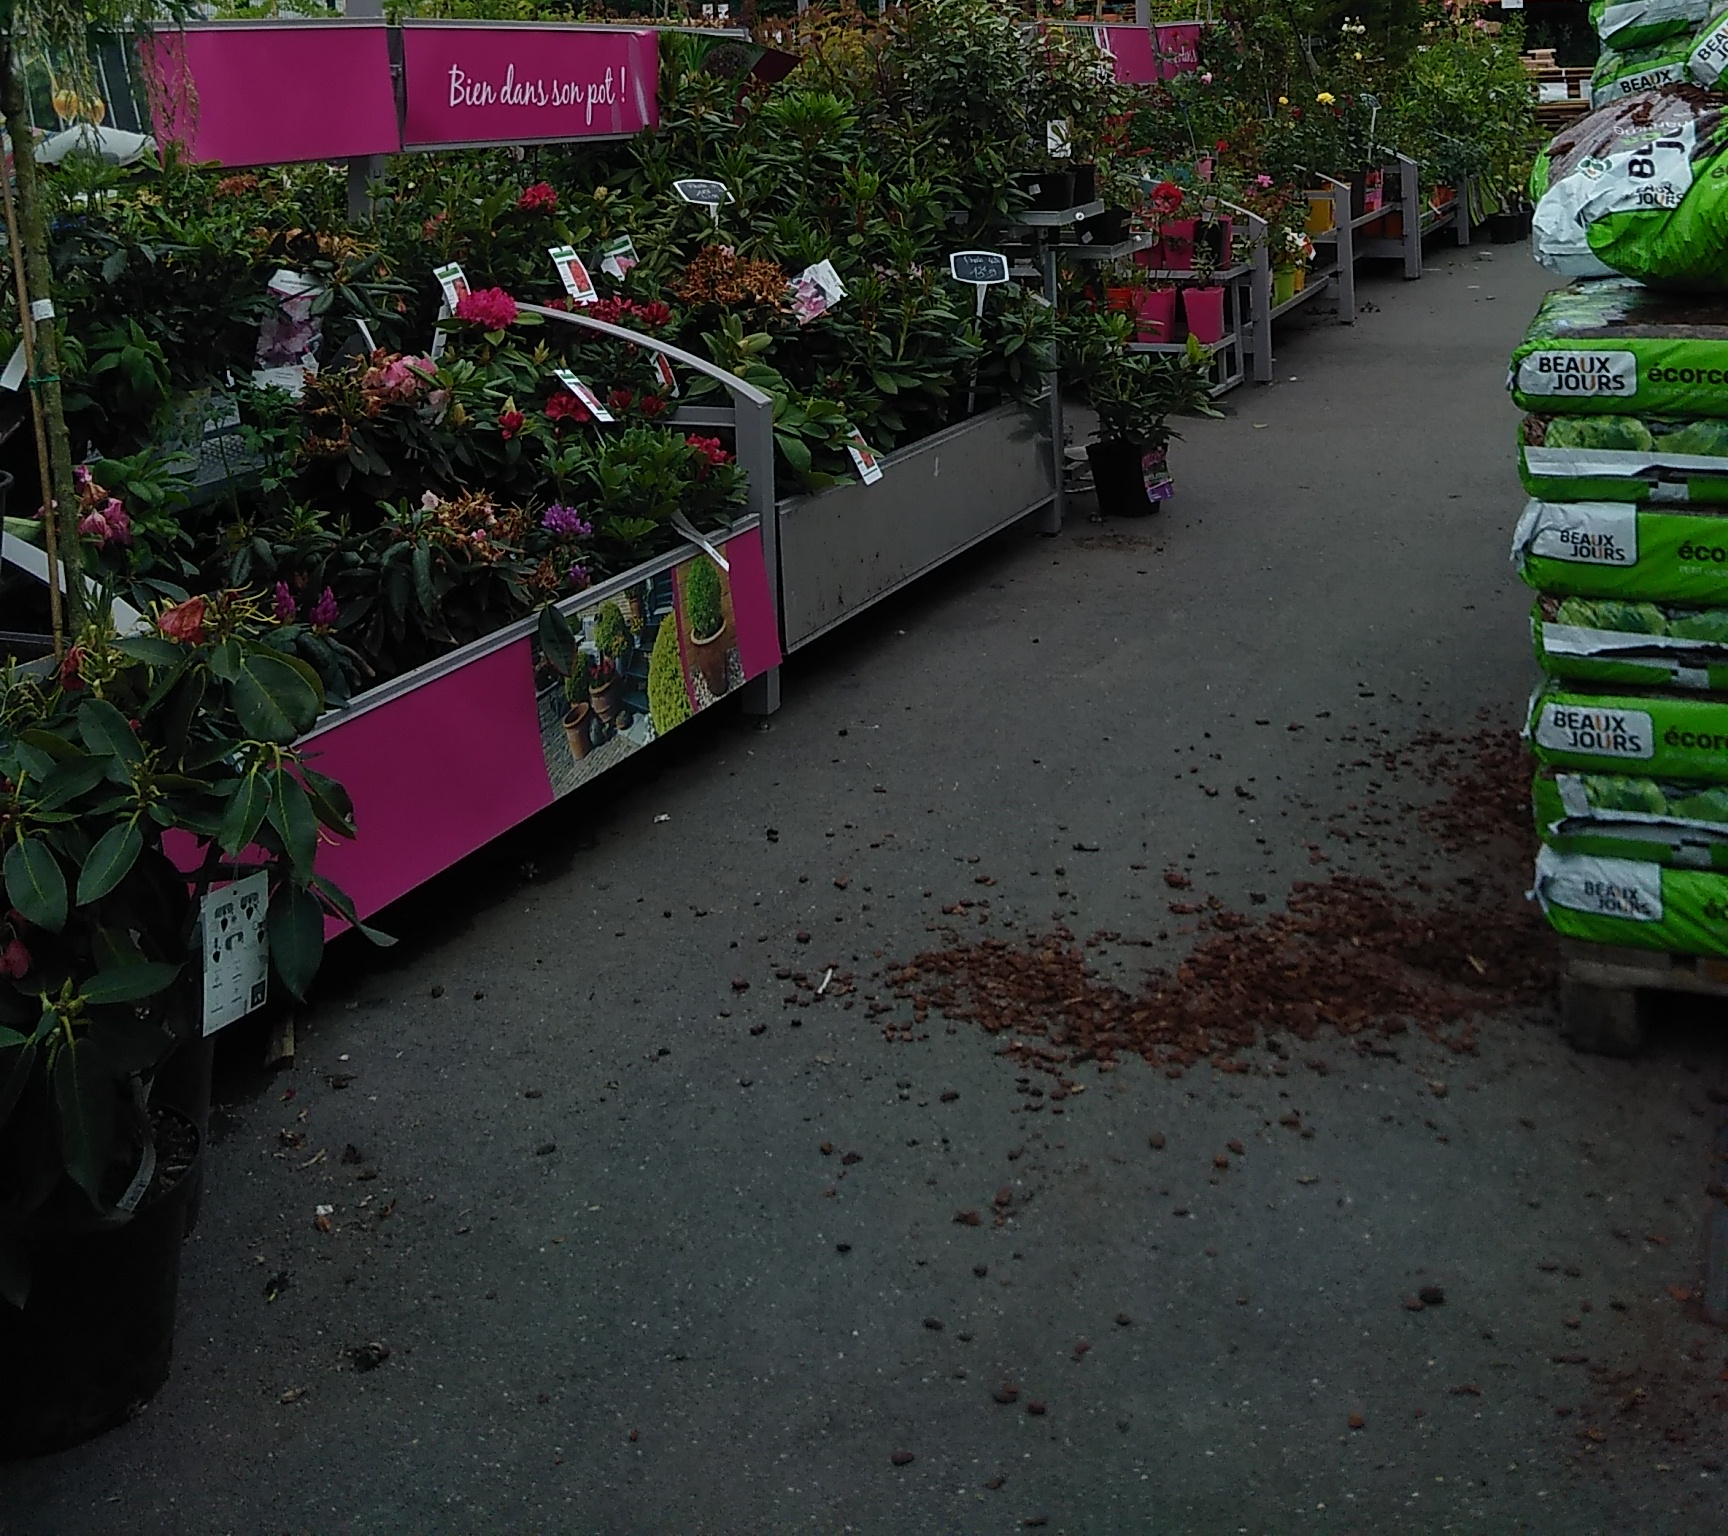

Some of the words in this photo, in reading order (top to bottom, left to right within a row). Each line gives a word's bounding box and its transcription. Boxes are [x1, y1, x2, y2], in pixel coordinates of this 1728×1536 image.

[1619, 69, 1673, 94] BEAUX
[448, 63, 497, 107] Bien
[500, 63, 550, 106] dans
[551, 78, 585, 106] son
[585, 66, 616, 126] pot
[1538, 356, 1611, 375] BEAUX
[1552, 373, 1626, 392] JOURS
[1559, 530, 1615, 548] BEAUX
[1570, 544, 1626, 562] JOURS
[1553, 710, 1627, 734] BEAUX
[1568, 730, 1642, 753] JOURS
